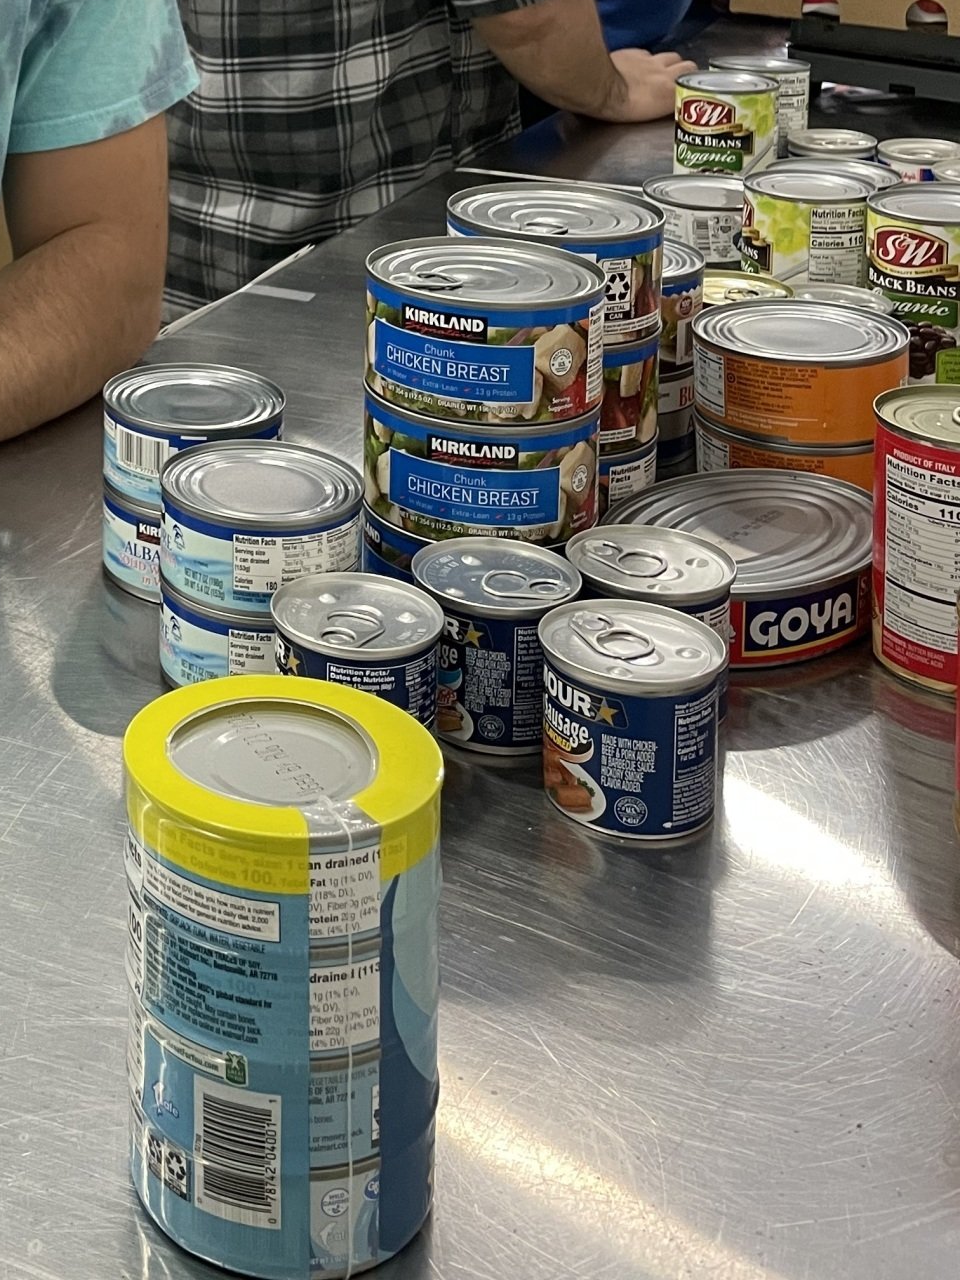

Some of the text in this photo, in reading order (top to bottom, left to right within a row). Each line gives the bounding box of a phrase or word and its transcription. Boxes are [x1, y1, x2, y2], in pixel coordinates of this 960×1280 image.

[684, 100, 729, 127] S&W
[677, 128, 742, 149] BLACK BEANS
[677, 143, 737, 166] Organic
[811, 208, 864, 219] Nutrition Facts
[811, 235, 864, 247] Calories 110
[878, 232, 939, 266] S&W
[868, 267, 957, 298] BLACK BEANS
[606, 304, 626, 312] METAL
[405, 306, 485, 333] KIRKLAND
[609, 312, 623, 320] CAN
[424, 343, 455, 359] Chunk
[386, 345, 510, 382] CHICKEN BREAST
[437, 399, 465, 411] DRAINED
[466, 402, 477, 412] WT
[431, 437, 516, 459] KIRKLAND
[893, 447, 956, 474] PRODUCT OF ITALY
[610, 464, 641, 476] Nutrition
[887, 456, 960, 488] Nutrition Facts
[453, 473, 487, 487] Chunk
[610, 475, 631, 484] Facts
[407, 476, 539, 506] CHICKEN BREAST
[887, 490, 919, 511] Calories
[451, 508, 490, 520] Extra-Lean
[452, 525, 464, 535] OZ)
[468, 527, 497, 537] DRAINED
[497, 529, 509, 537] WT
[234, 536, 277, 546] Nutrition Facts
[234, 547, 254, 556] Serving
[250, 557, 270, 565] drained
[234, 576, 278, 591] Calories 180
[749, 592, 852, 648] GOYA
[230, 630, 272, 642] Nutrition Facts
[230, 642, 250, 651] Serving
[245, 652, 265, 660] drained
[329, 665, 390, 677] Nutrition Facts/
[329, 672, 351, 681] Datos
[352, 674, 362, 682] de
[601, 733, 617, 745] MADE
[617, 737, 632, 749] WITH
[601, 744, 615, 756] BEEF
[620, 749, 636, 761] PORK
[636, 751, 655, 763] ADDED
[607, 757, 636, 771] BARBECUE
[601, 765, 644, 783] HICKORY SMOKE
[600, 776, 621, 790] FLAVOR
[325, 853, 369, 869] drained
[310, 878, 326, 888] Fat
[329, 877, 339, 888] 1g
[315, 890, 337, 902] (18%
[205, 895, 216, 905] you
[216, 898, 229, 909] how
[230, 901, 246, 913] much
[253, 907, 275, 917] nutrient
[327, 900, 348, 911] Fiber
[196, 908, 217, 923] general
[222, 908, 237, 919] daily
[251, 915, 269, 925] 2,000
[327, 924, 343, 936] (4%
[311, 1015, 332, 1025] Fiber
[311, 1039, 328, 1050] (4%
[265, 1166, 277, 1202] 78742
